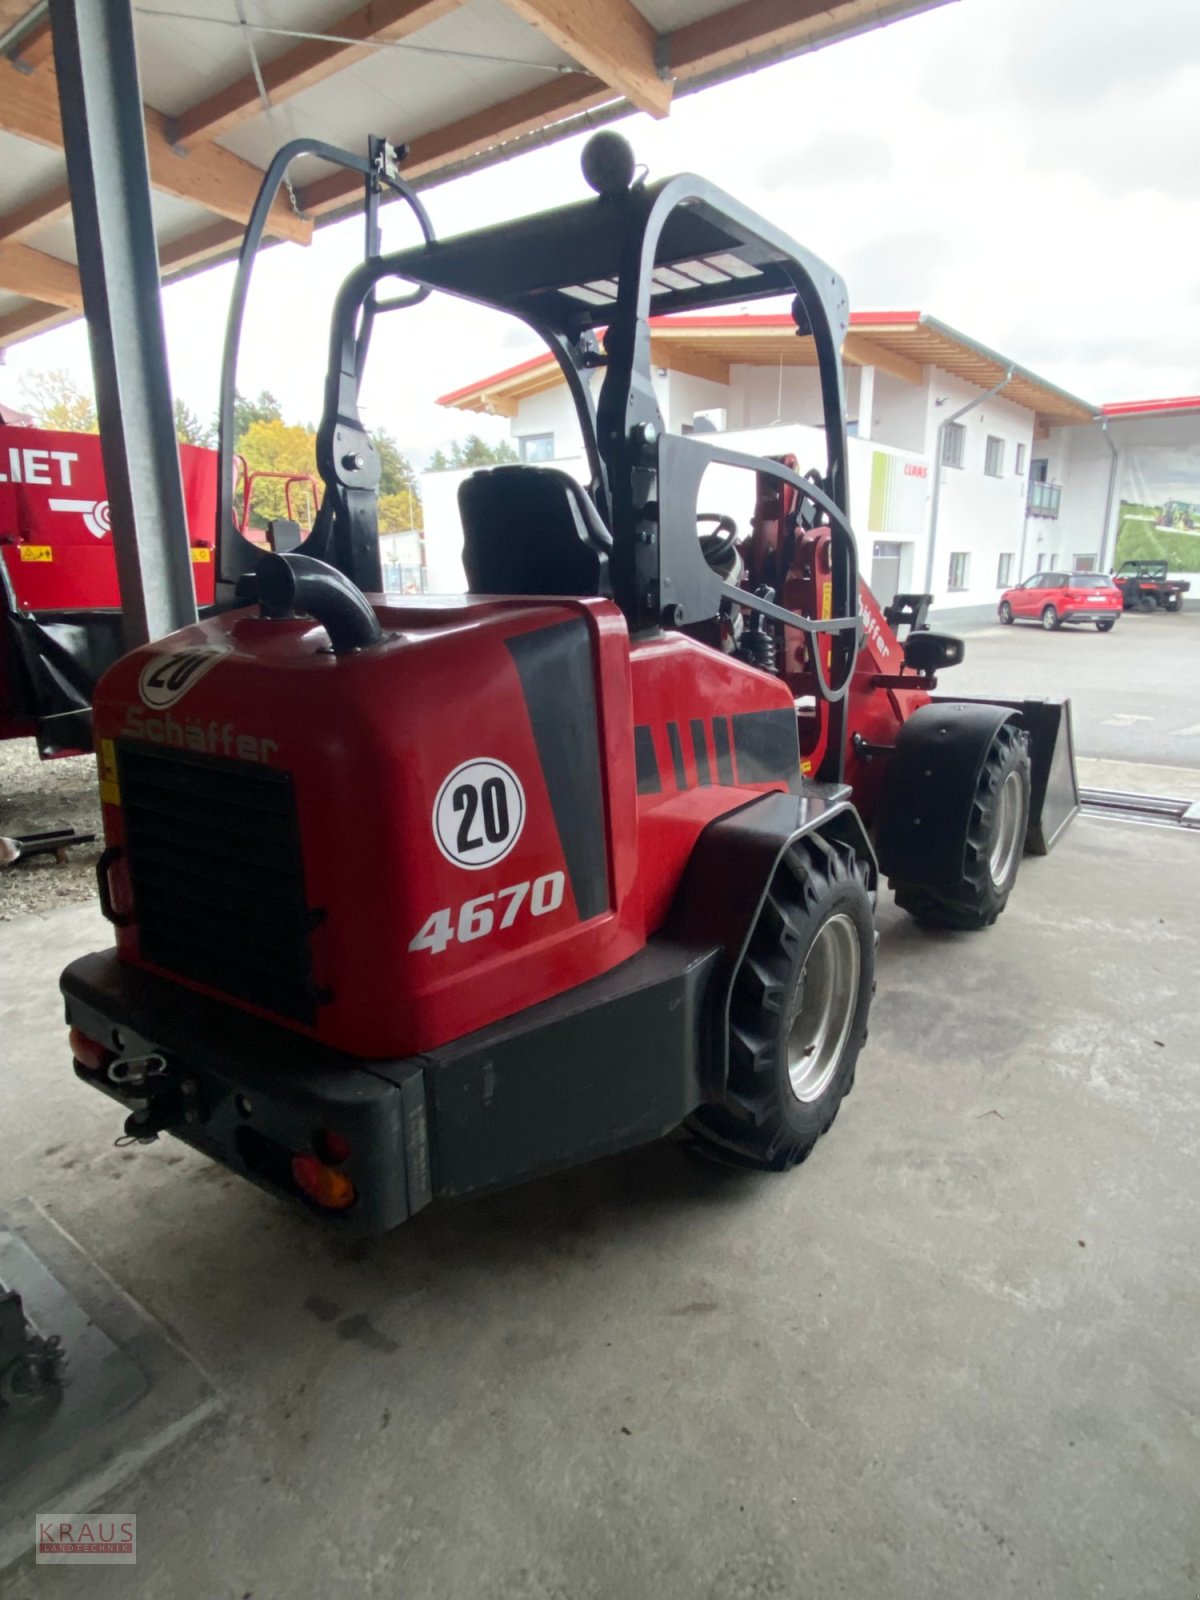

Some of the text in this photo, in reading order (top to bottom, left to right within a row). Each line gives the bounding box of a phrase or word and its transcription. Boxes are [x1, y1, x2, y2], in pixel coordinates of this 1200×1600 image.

[0, 447, 78, 487] IET
[146, 650, 214, 691] 20
[120, 706, 279, 763] Schäffer
[452, 776, 510, 854] 20
[407, 870, 566, 956] 4670
